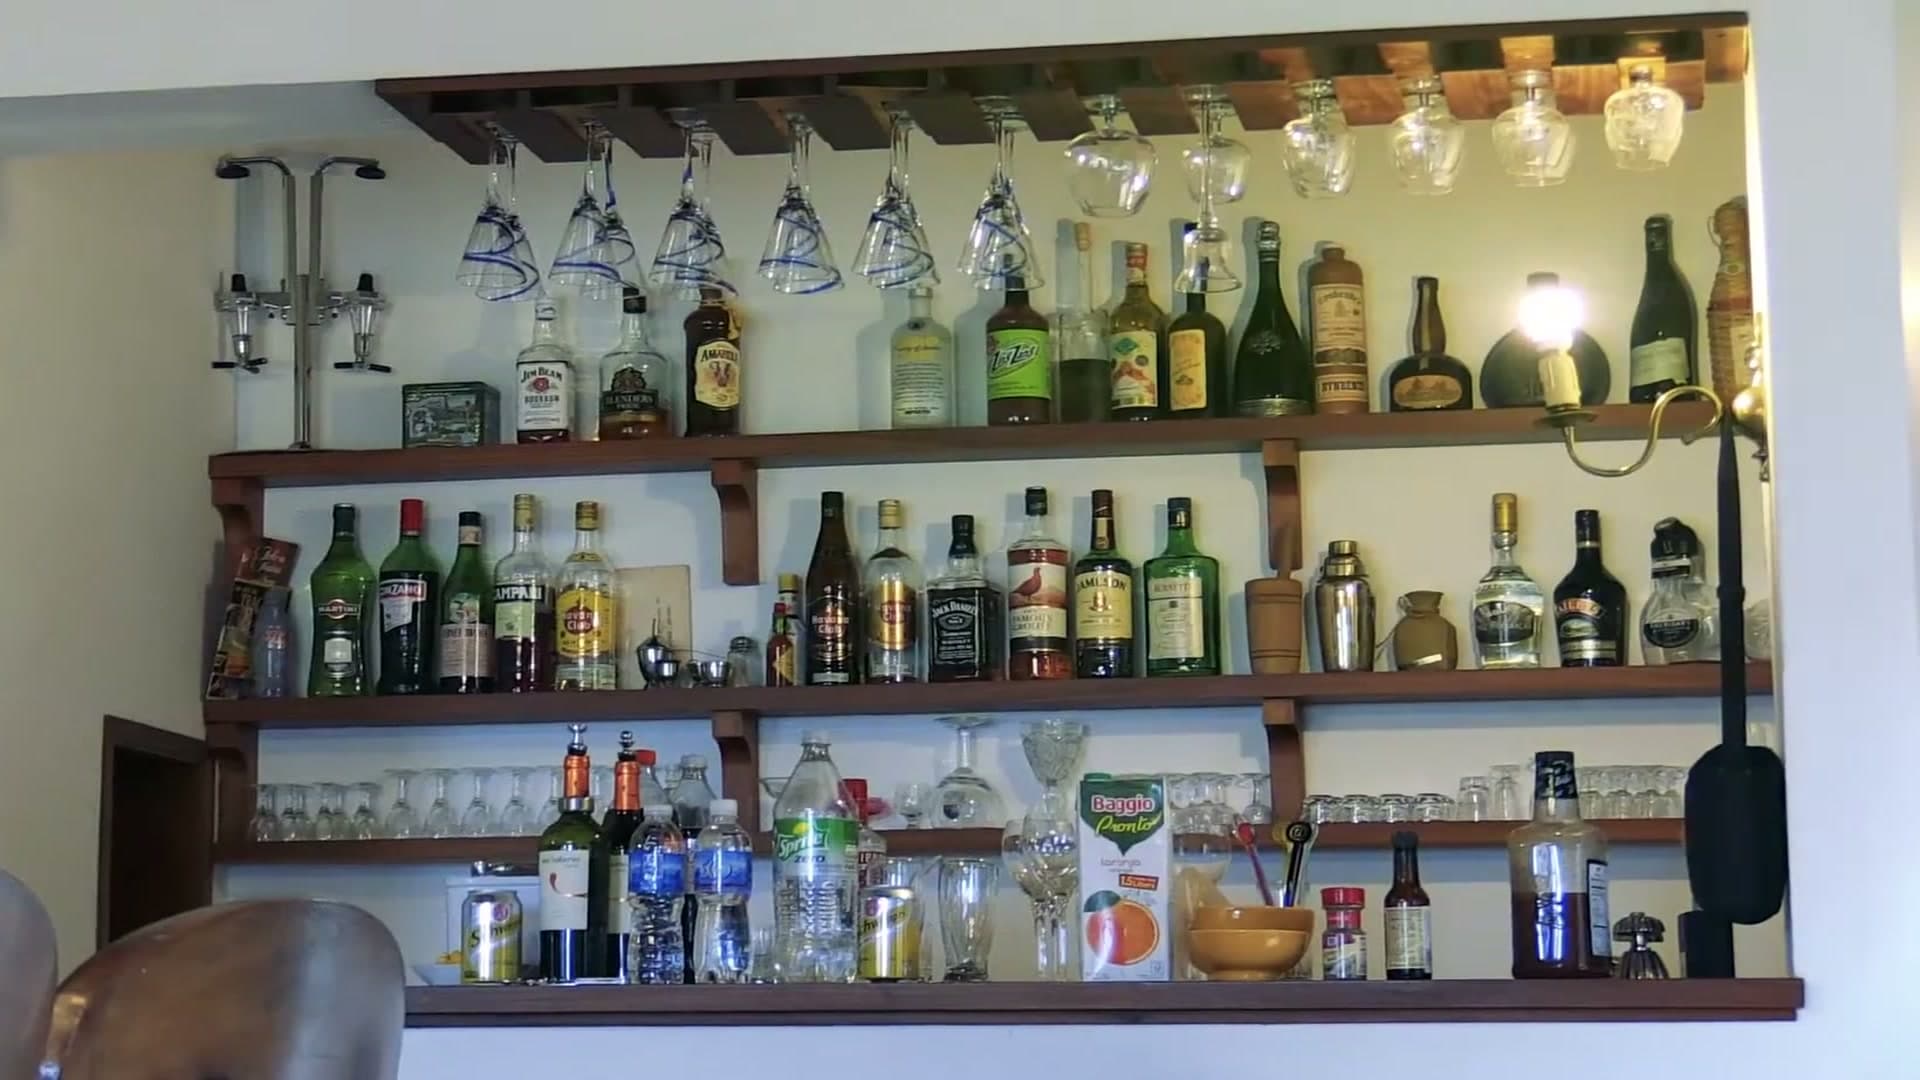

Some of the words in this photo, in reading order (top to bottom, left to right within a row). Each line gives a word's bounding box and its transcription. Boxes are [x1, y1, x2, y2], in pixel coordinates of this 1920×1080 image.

[521, 369, 537, 383] JIM
[538, 367, 562, 381] BEAM
[932, 604, 949, 618] JACK
[1091, 794, 1155, 816] Baggio
[1095, 815, 1161, 835] Pronto
[778, 834, 826, 858] Sprie
